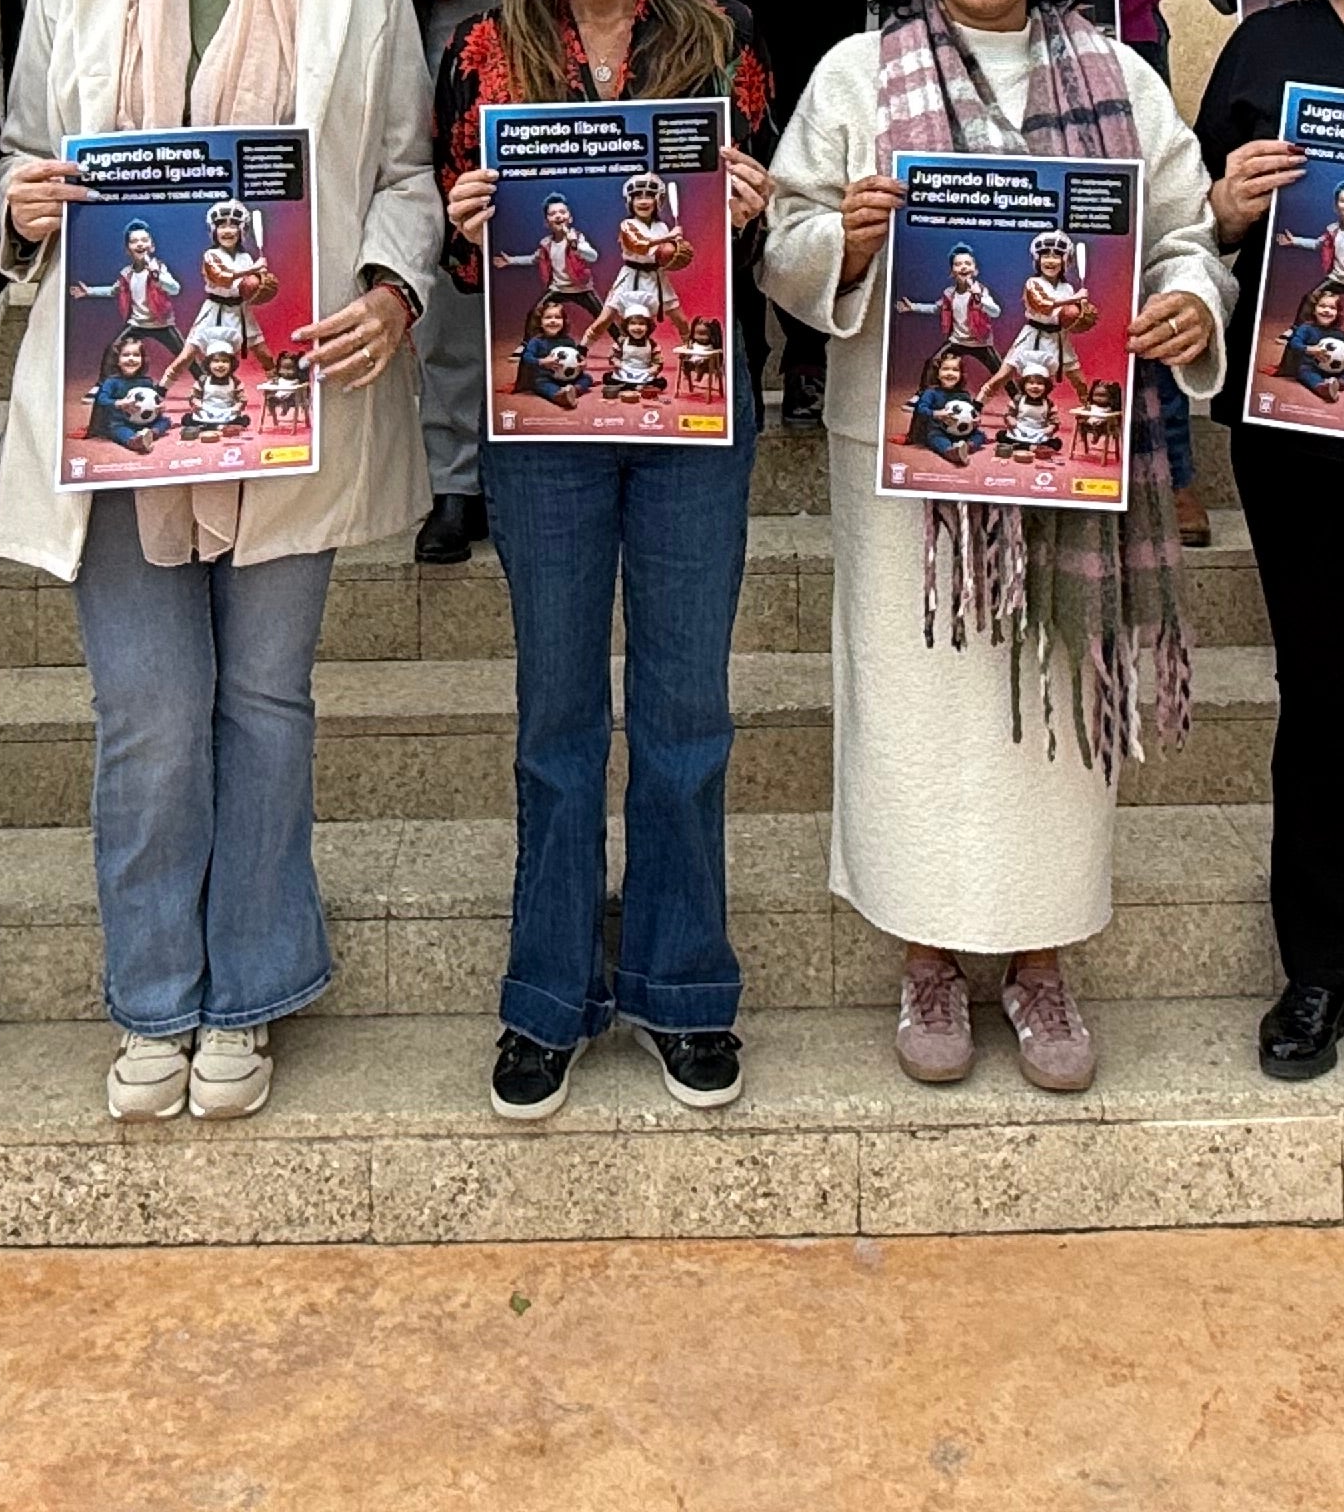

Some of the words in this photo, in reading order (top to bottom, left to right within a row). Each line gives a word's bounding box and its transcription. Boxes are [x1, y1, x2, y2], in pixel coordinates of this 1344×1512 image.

[500, 122, 571, 140] Jugando
[574, 120, 622, 136] libres,
[500, 139, 580, 156] creciendo
[582, 137, 645, 156] iguales.
[84, 148, 154, 167] Jugando
[156, 146, 206, 161] libres,
[81, 166, 162, 182] creciendo
[164, 164, 230, 182] iguales.
[912, 171, 983, 188] Jugando
[986, 172, 1033, 190] libres,
[911, 189, 991, 205] creciendo
[993, 190, 1056, 209] iguales.
